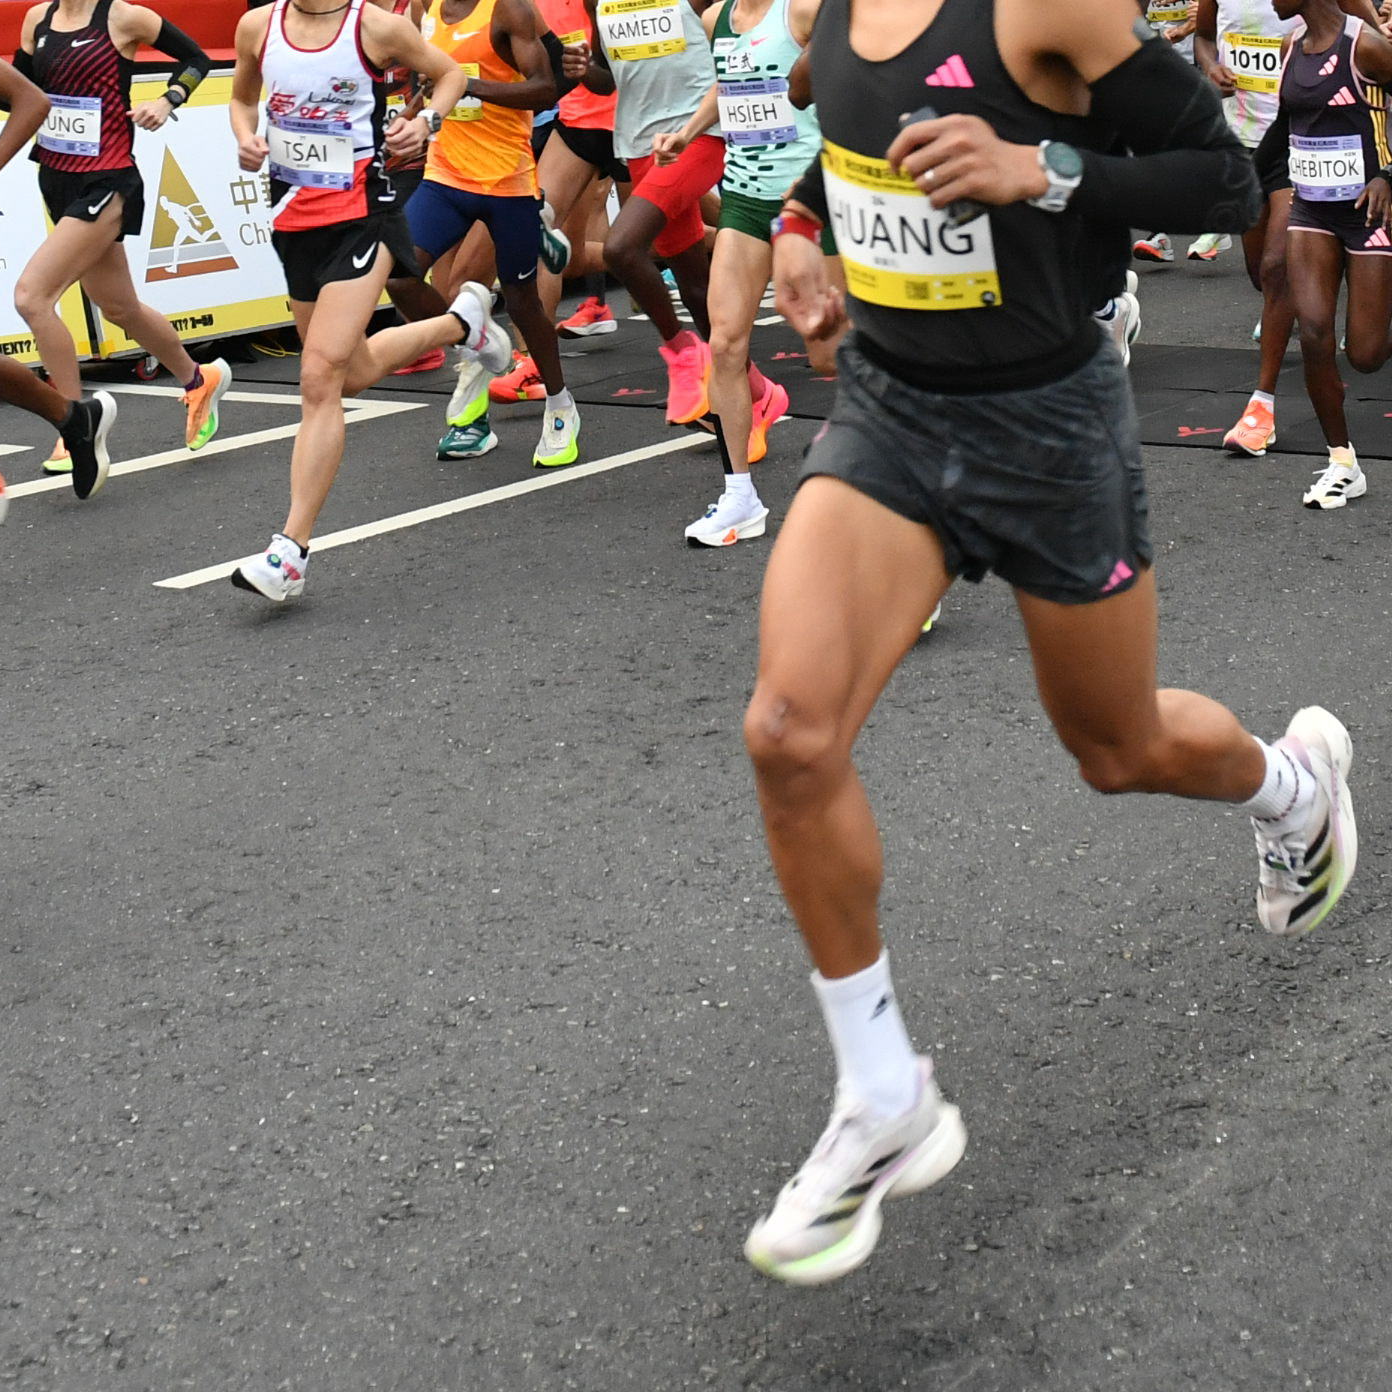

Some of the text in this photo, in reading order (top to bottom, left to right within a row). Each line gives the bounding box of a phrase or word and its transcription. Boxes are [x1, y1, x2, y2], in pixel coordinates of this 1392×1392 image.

[608, 16, 671, 40] KAMETO
[1230, 48, 1281, 71] 1010
[727, 103, 777, 123] HSIEH
[48, 115, 85, 134] UNG
[283, 140, 327, 162] TSAI
[1291, 157, 1359, 178] CHEBITOK
